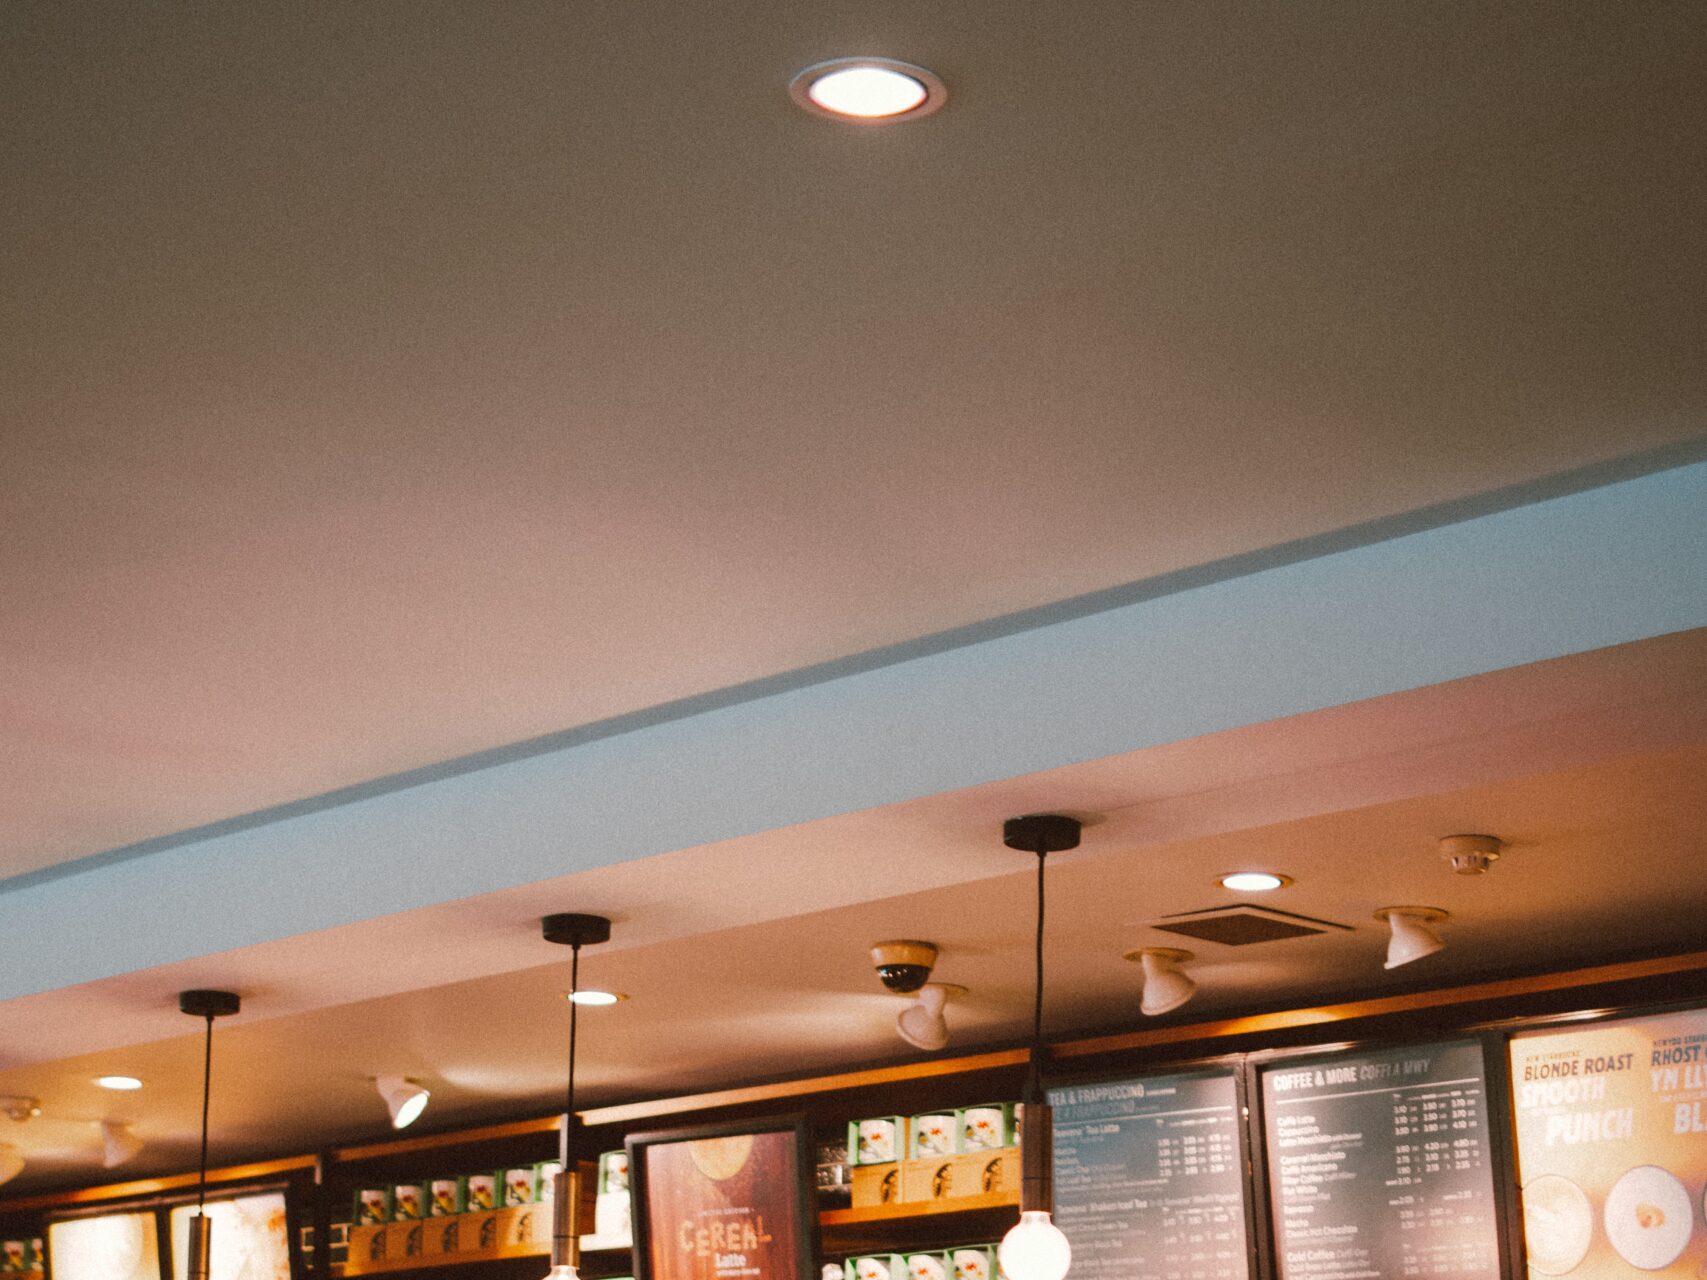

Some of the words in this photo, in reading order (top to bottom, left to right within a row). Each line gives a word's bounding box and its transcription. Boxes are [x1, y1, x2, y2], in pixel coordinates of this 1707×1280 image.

[1524, 1060, 1579, 1081] BLONDE
[1584, 1053, 1634, 1075] ROAST
[1651, 1045, 1702, 1066] RHOST
[1273, 1072, 1313, 1091] COFFEE
[1314, 1070, 1325, 1086] &
[1326, 1066, 1358, 1084] MORE
[1649, 1067, 1679, 1092] YN
[1047, 1091, 1067, 1105] TEA
[1067, 1090, 1077, 1104] &
[1078, 1083, 1145, 1104] FRAPPUCCINO
[1521, 1076, 1607, 1108] SMOOTH
[1545, 1107, 1634, 1147] PUNCH
[1673, 1101, 1707, 1136] BL
[679, 1215, 773, 1258] CEREAL
[714, 1252, 747, 1268] Latte
